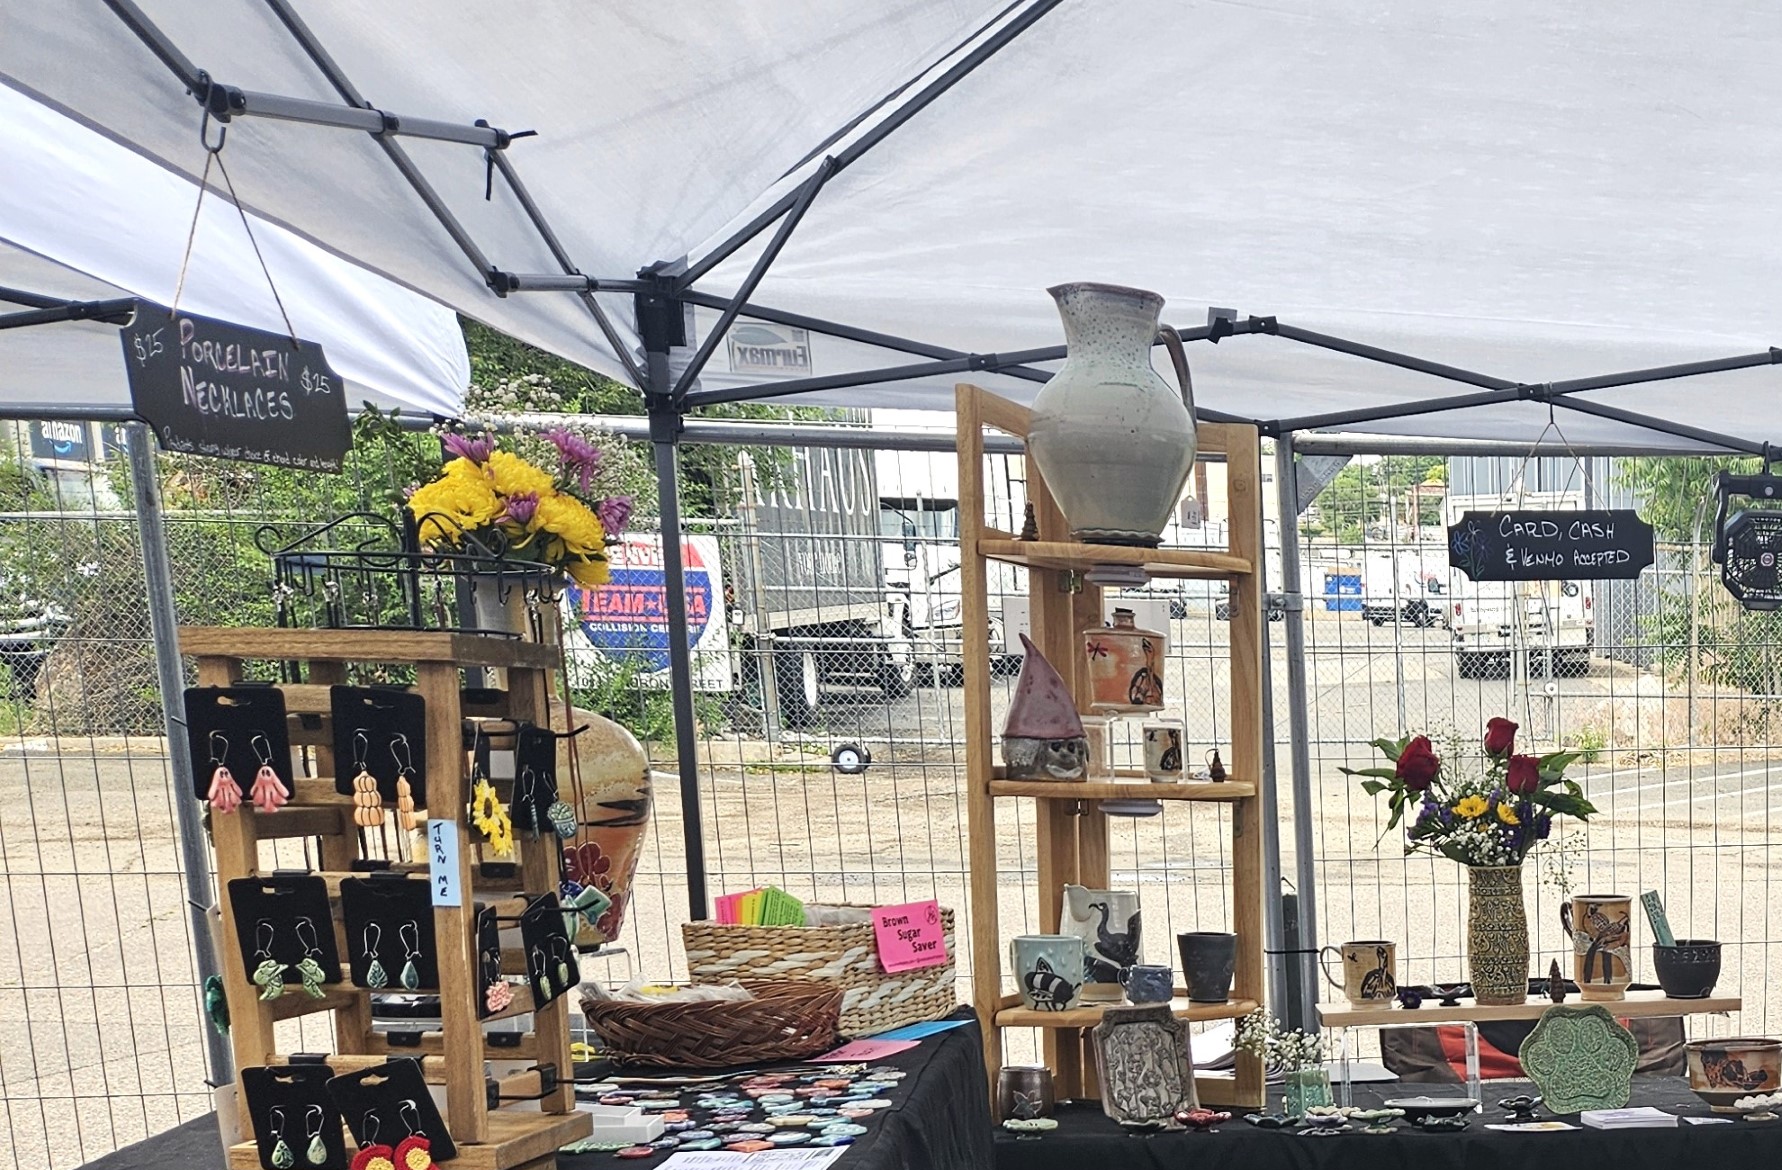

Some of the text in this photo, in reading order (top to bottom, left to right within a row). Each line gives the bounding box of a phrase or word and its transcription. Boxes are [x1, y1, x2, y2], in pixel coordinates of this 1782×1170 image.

[133, 327, 164, 367] $25
[179, 318, 290, 381] PORCELAIN
[180, 365, 294, 420] NECKLACES
[300, 365, 331, 395] $25
[41, 420, 82, 443] amazon
[1499, 514, 1615, 541] CARD, CASH
[1505, 543, 1630, 570] & VENMO ACCEPTED
[581, 589, 645, 614] TEAM
[589, 623, 648, 633] COLLISION
[433, 822, 448, 897] TURN ME
[881, 915, 909, 928] Brown
[897, 928, 922, 942] Sugar
[912, 940, 937, 953] Saver
